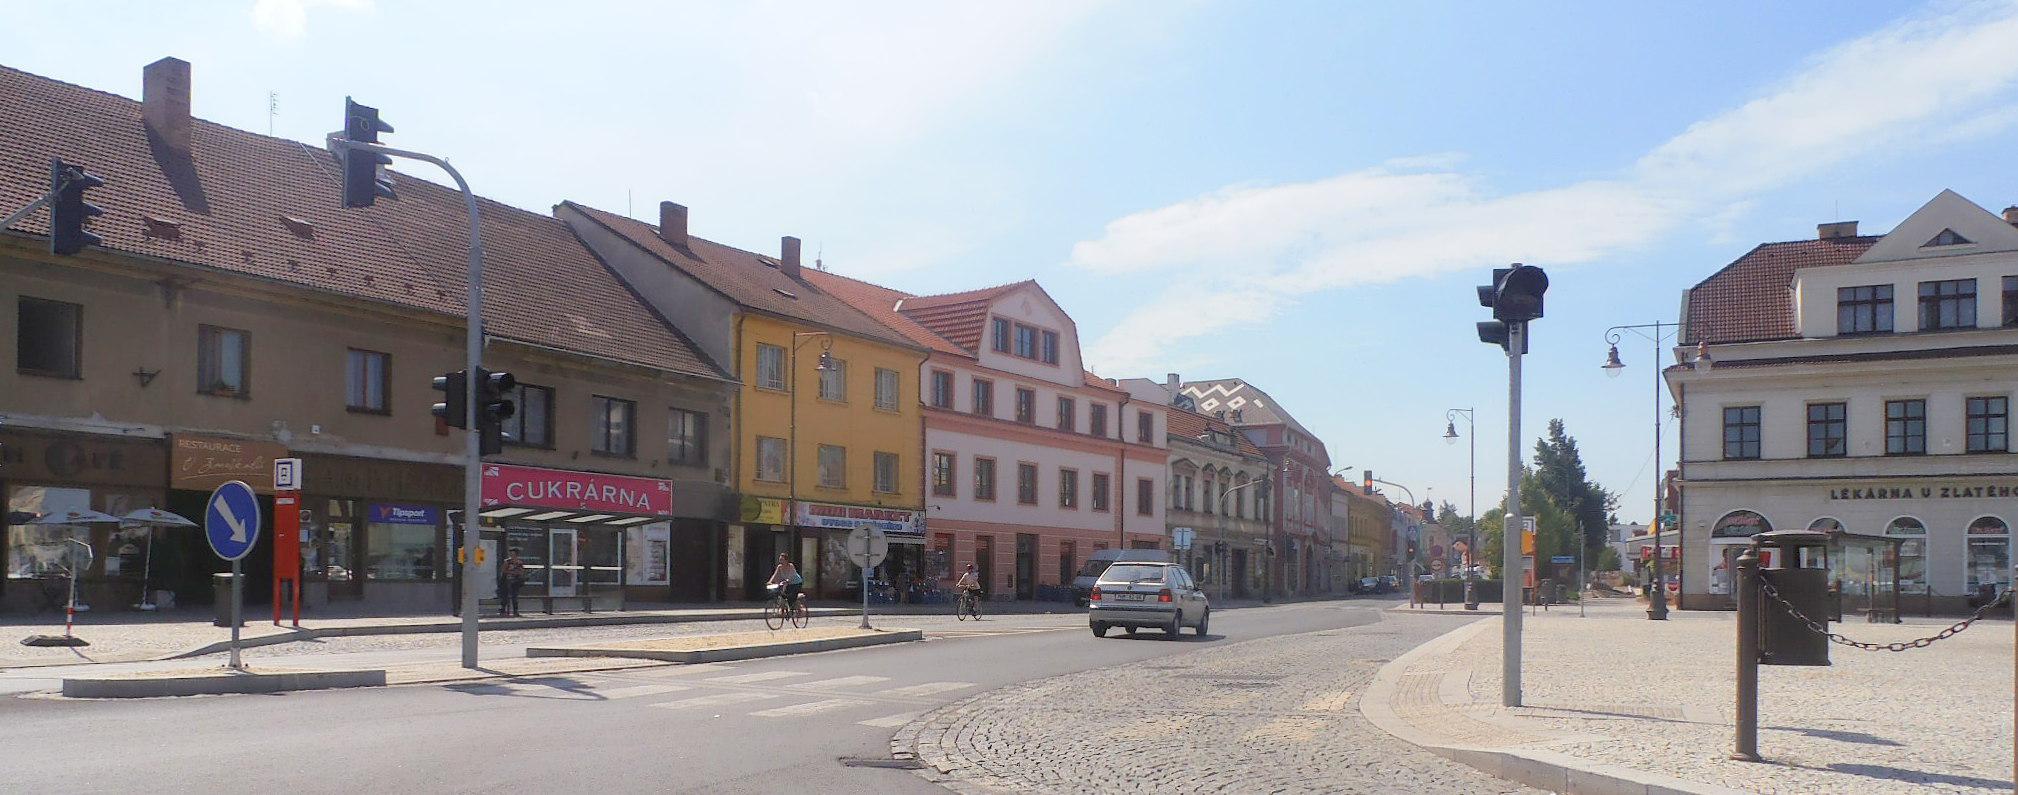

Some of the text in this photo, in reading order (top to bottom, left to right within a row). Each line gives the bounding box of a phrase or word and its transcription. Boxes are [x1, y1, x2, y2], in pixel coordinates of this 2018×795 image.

[178, 440, 240, 453] RESTAURACE
[507, 479, 650, 510] CUKRÁRNA
[1830, 486, 1912, 500] LÉKÁRNA
[1921, 487, 1932, 498] U
[392, 507, 425, 518] Tipsport
